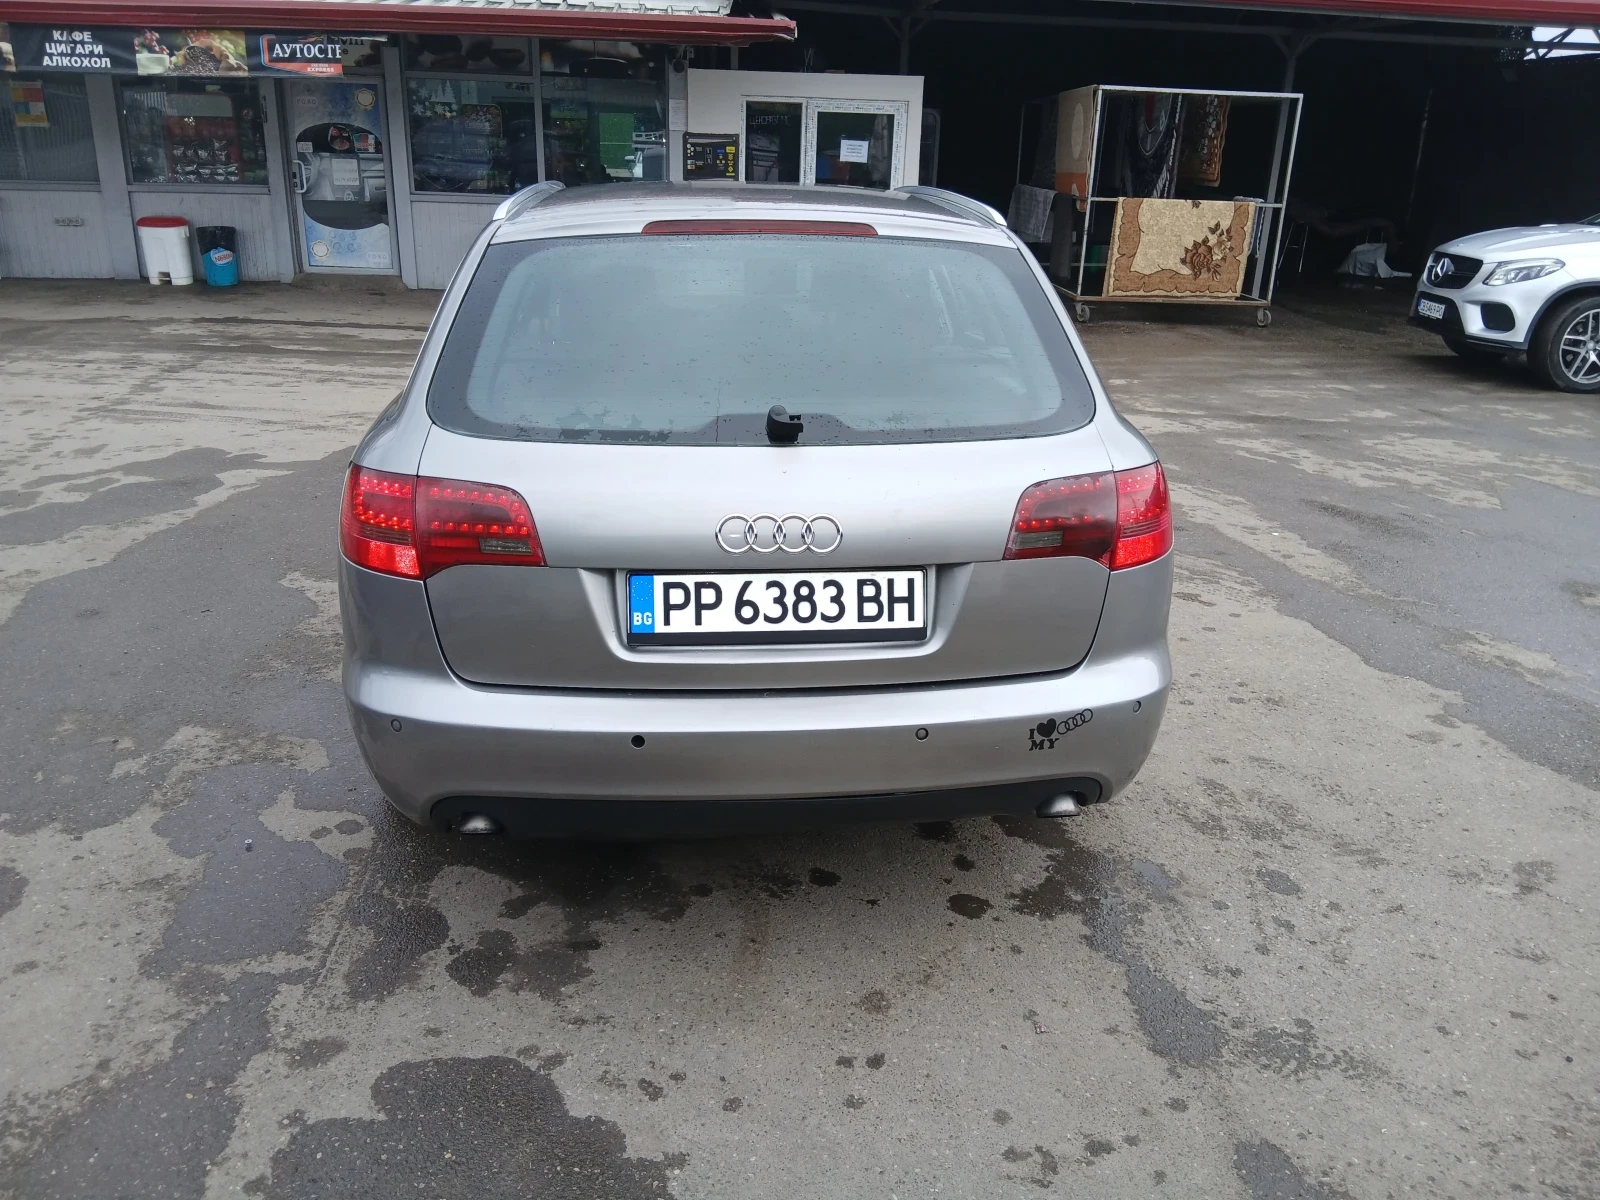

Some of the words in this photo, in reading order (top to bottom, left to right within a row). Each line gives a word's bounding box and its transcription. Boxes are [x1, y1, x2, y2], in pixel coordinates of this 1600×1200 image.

[45, 43, 103, 55] ЦИГАРИ
[43, 56, 111, 68] АЛКОХОЛ
[662, 581, 723, 626] PP
[734, 579, 846, 625] 6383
[857, 578, 915, 623] BH
[633, 611, 653, 626] BG
[1029, 737, 1060, 751] MY
